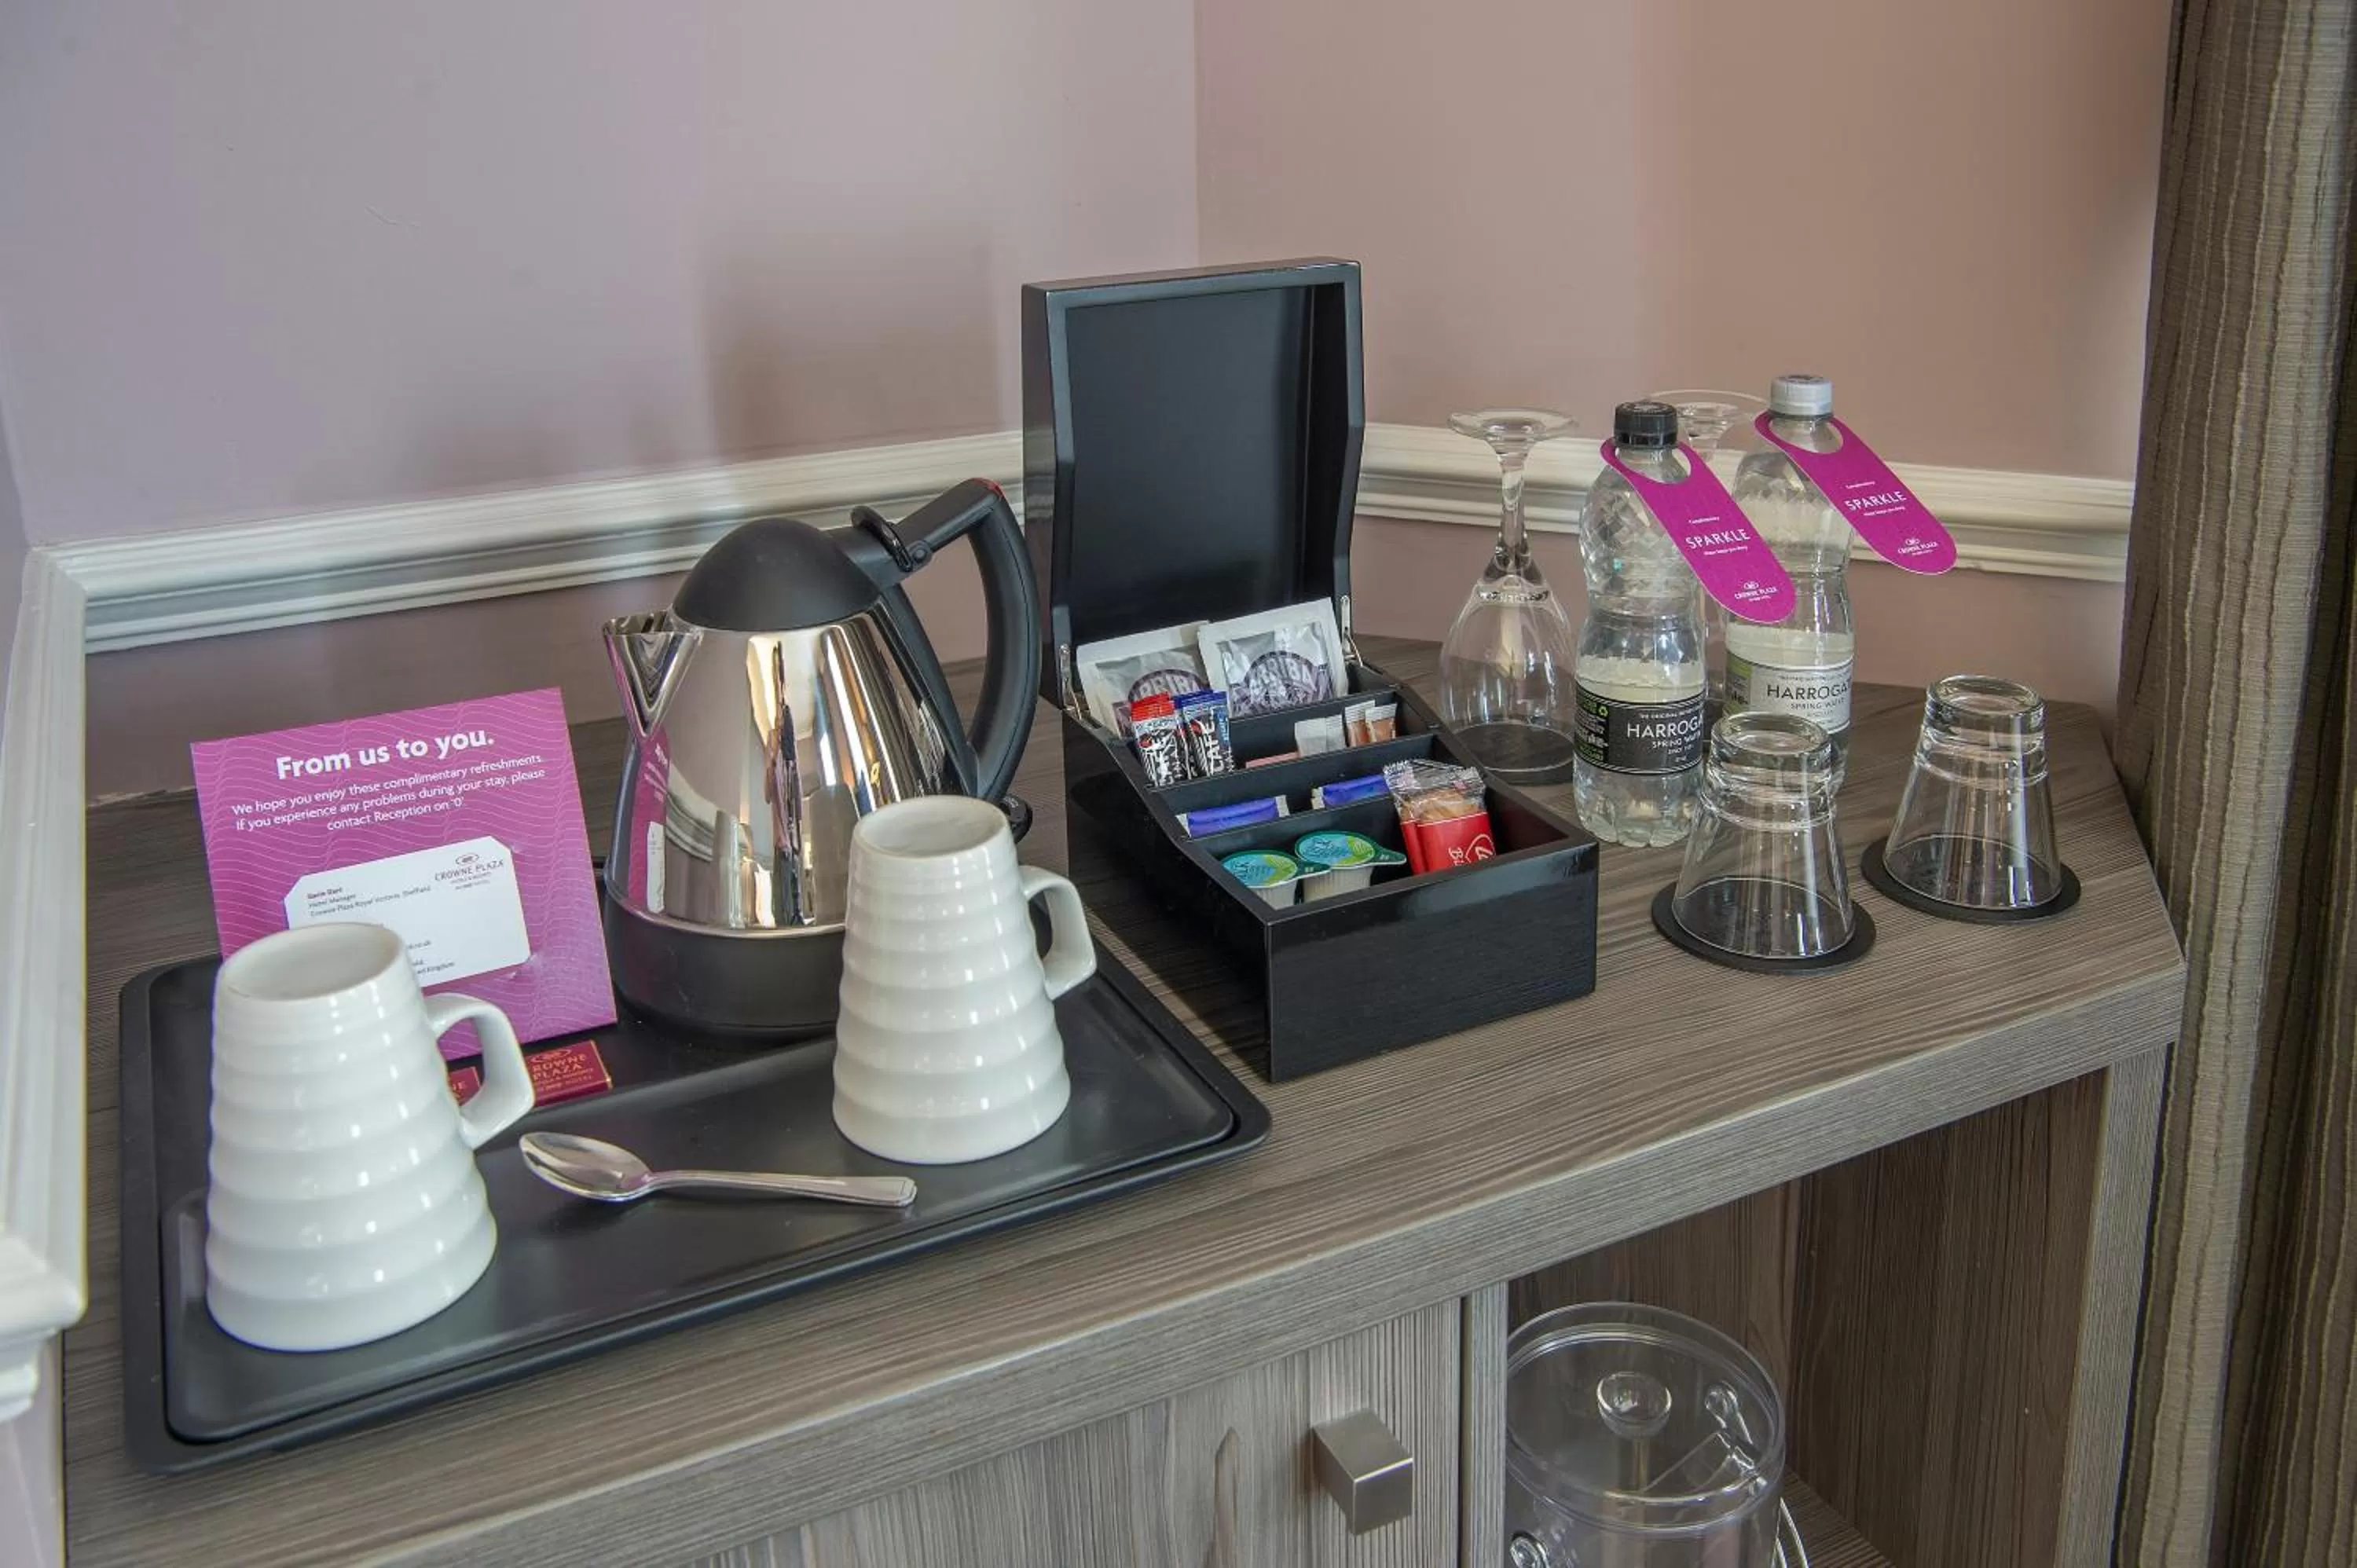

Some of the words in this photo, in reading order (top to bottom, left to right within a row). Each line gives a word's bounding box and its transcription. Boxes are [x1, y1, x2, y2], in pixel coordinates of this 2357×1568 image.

[1844, 491, 1907, 511] SPARKLE
[1685, 529, 1750, 549] SPARKLE
[1767, 683, 1848, 700] HARROGA
[1627, 713, 1703, 738] HARROGA
[277, 752, 351, 779] From
[358, 746, 390, 766] us
[395, 738, 428, 758] to
[434, 730, 495, 760] you.
[232, 804, 253, 815] We
[255, 798, 287, 812] hope
[289, 794, 313, 808] you
[314, 788, 346, 803] enjoy
[349, 782, 381, 795] these
[383, 767, 468, 789] complimentary
[236, 819, 245, 830] If
[247, 816, 271, 832] you
[273, 805, 337, 824] experience
[340, 800, 360, 814] any
[362, 792, 416, 811] problems
[419, 786, 455, 800] during
[456, 779, 483, 795] your
[511, 769, 546, 785] please
[327, 815, 372, 831] contact
[374, 803, 431, 822] Reception
[434, 800, 449, 811] on
[434, 865, 473, 881] CROWNE
[475, 859, 504, 872] PLAZA
[533, 1053, 587, 1072] ROWNE
